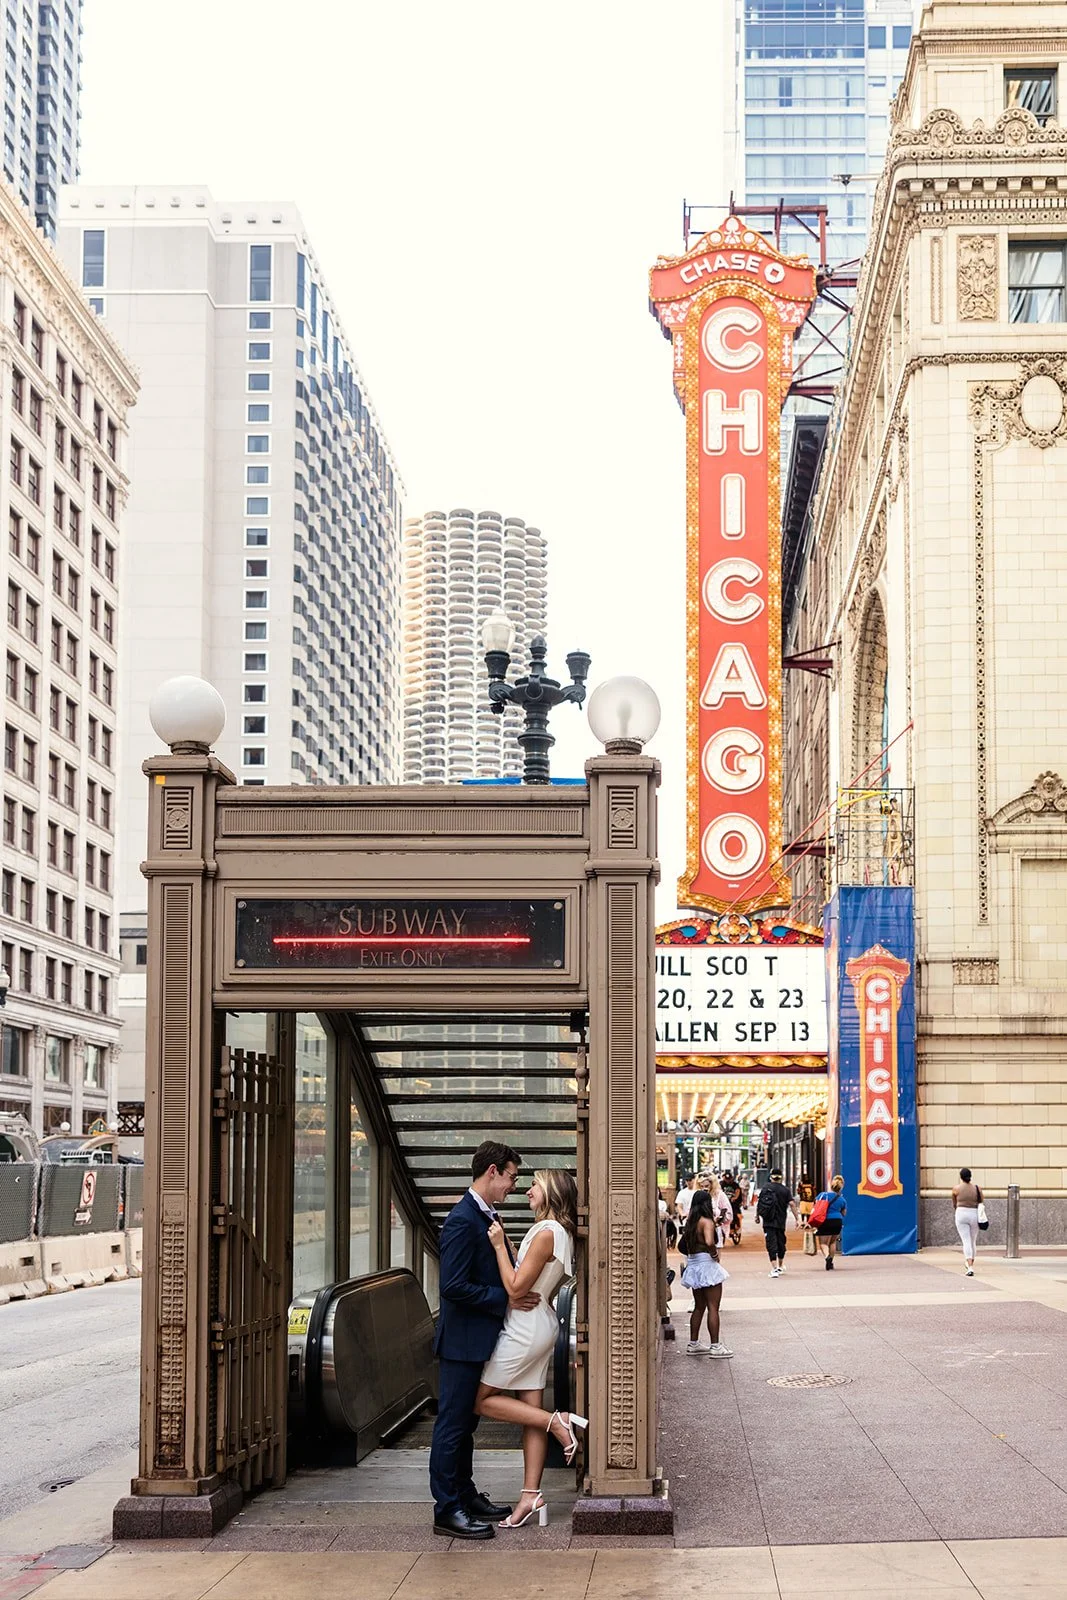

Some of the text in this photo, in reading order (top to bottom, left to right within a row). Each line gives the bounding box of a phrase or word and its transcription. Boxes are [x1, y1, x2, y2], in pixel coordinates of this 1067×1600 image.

[680, 253, 762, 284] CHASE
[701, 306, 768, 880] CHICAGO
[339, 908, 467, 935] SUBWAY
[401, 948, 446, 967] ONLY
[657, 988, 804, 1012] 20, 22 & 23
[734, 1022, 777, 1042] SEP
[791, 1021, 810, 1042] 13
[866, 978, 893, 1186] CHICAGO
